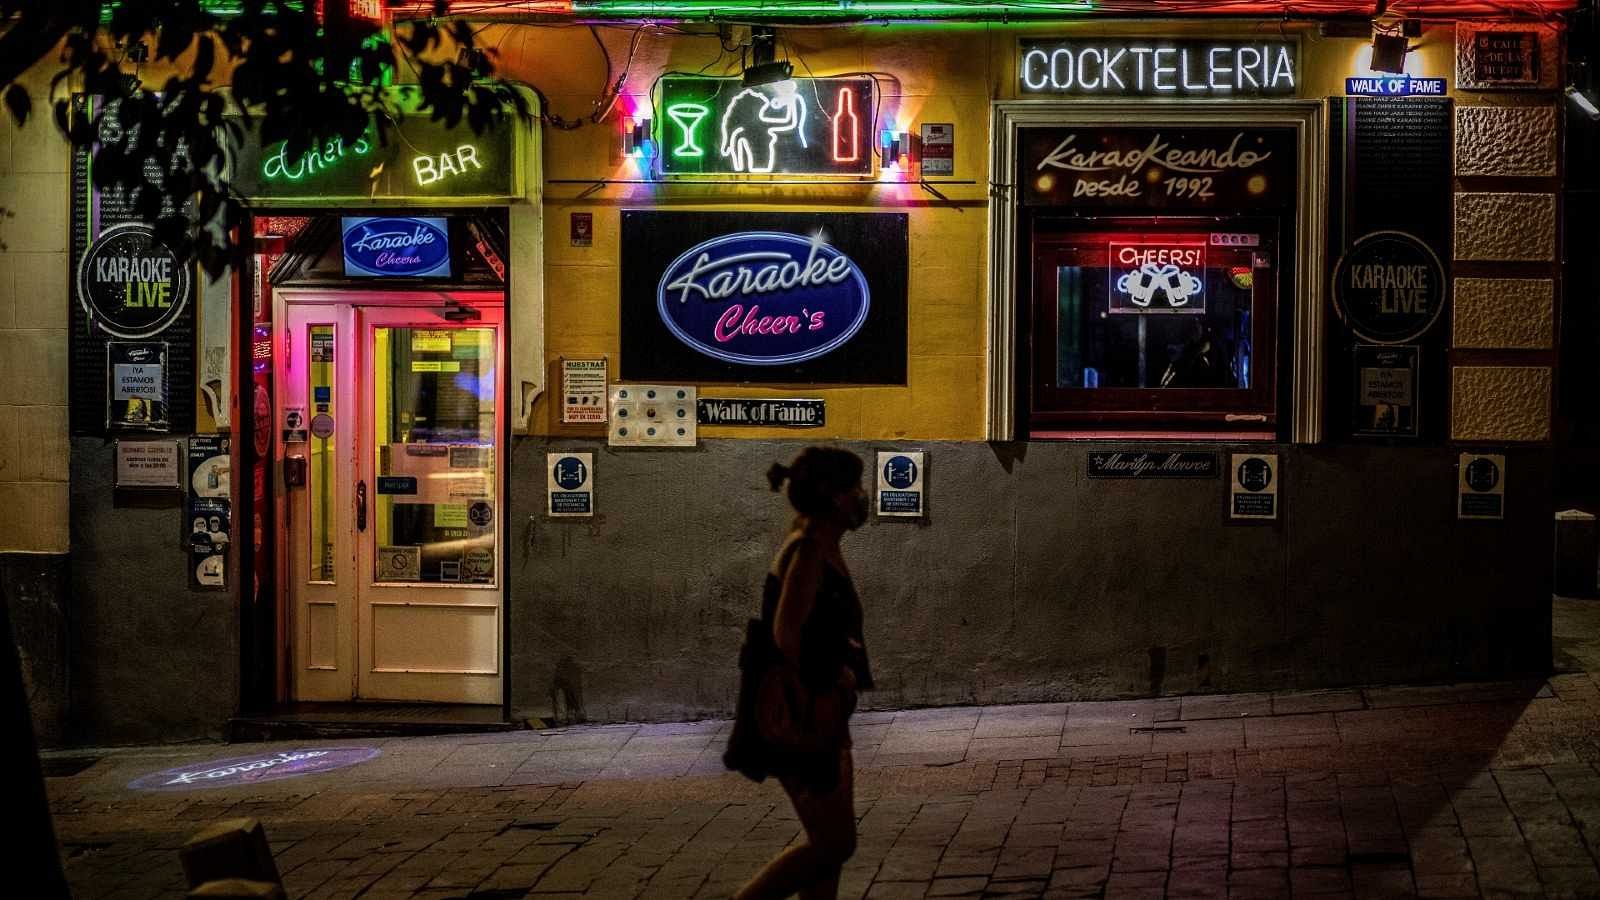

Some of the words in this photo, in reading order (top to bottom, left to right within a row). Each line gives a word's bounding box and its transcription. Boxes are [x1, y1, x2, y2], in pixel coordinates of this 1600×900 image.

[1024, 46, 1295, 90] COCKTELERIA
[1351, 79, 1384, 93] WALK
[1388, 79, 1405, 93] OF
[1409, 79, 1441, 93] FAME
[413, 143, 482, 186] BAR
[1163, 176, 1215, 198] 1992
[351, 224, 436, 253] Karaoke
[96, 256, 172, 282] KARAOKE
[1119, 247, 1201, 266] CHEERS!
[666, 240, 851, 304] Karaoke
[1351, 263, 1428, 289] KARAOKE
[126, 282, 171, 308] LIVE
[1380, 288, 1426, 313] LIVE
[705, 402, 749, 423] Walk
[750, 403, 767, 421] of
[769, 403, 816, 422] Fame
[1098, 453, 1155, 477] Marilyn
